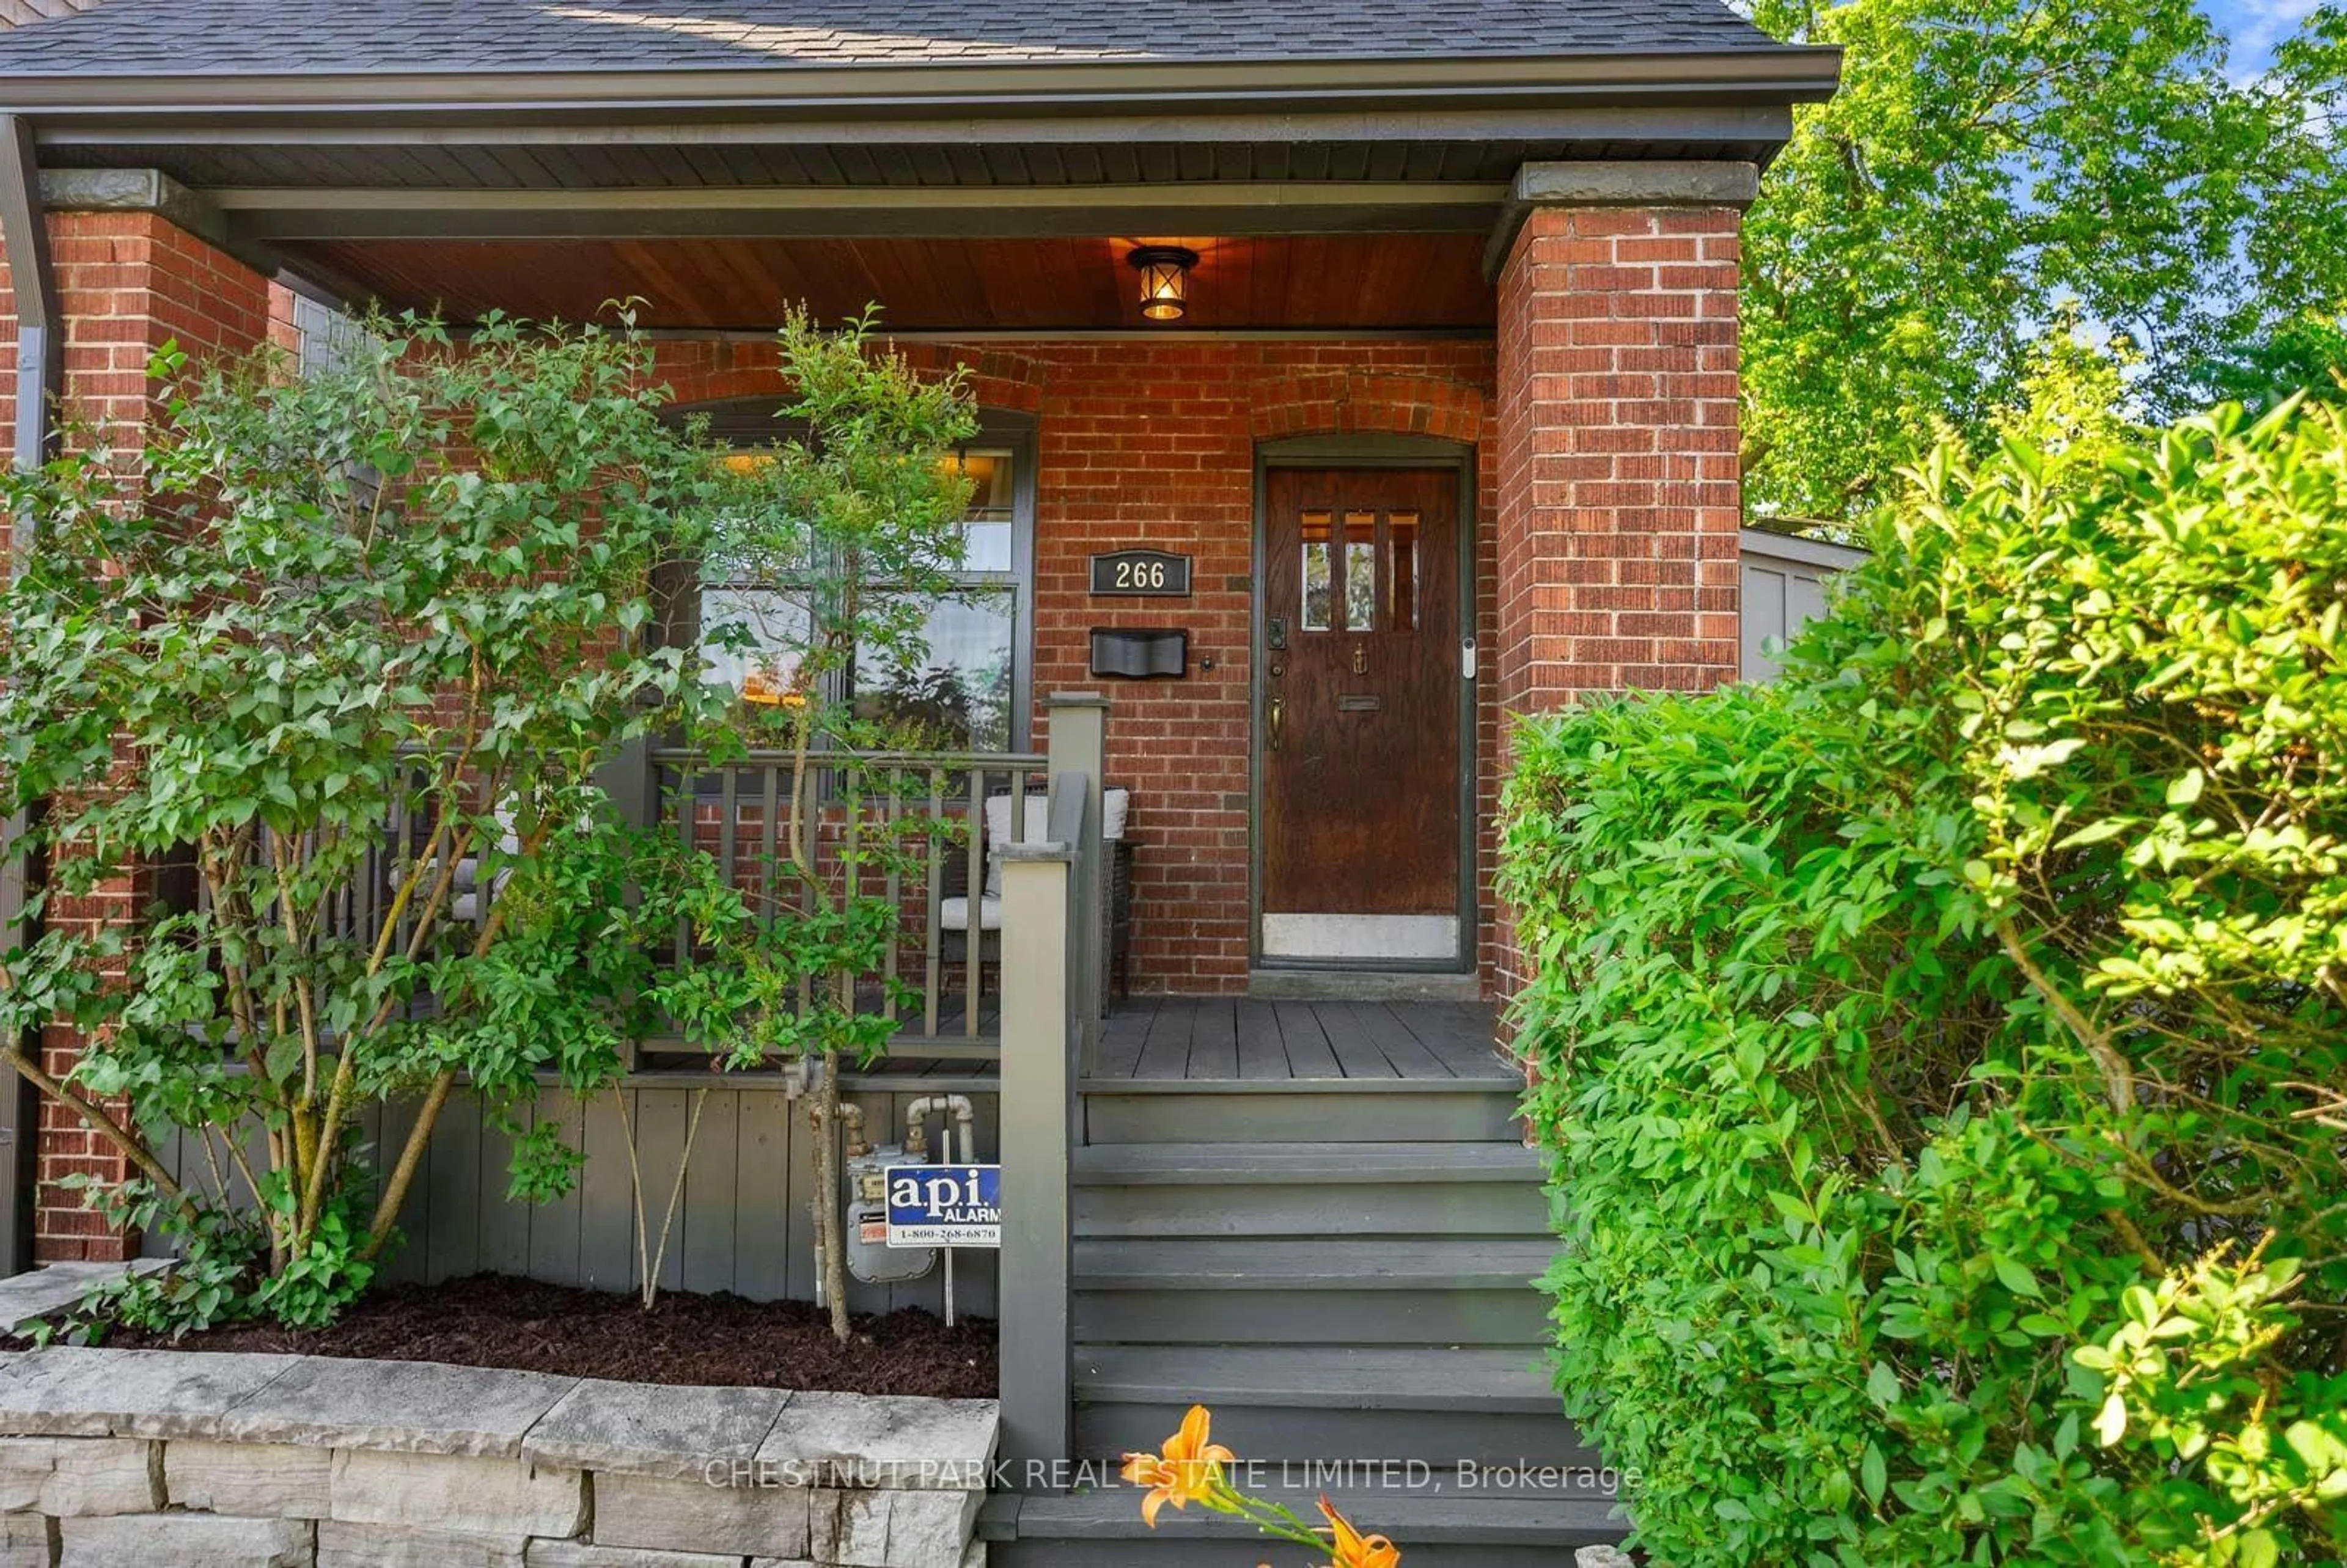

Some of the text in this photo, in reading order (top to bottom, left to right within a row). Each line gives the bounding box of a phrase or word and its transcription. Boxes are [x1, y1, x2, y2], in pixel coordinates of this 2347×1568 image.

[1115, 562, 1164, 588] 266
[944, 1208, 1002, 1222] ALARM
[901, 1229, 996, 1239] 1-800-268-6870
